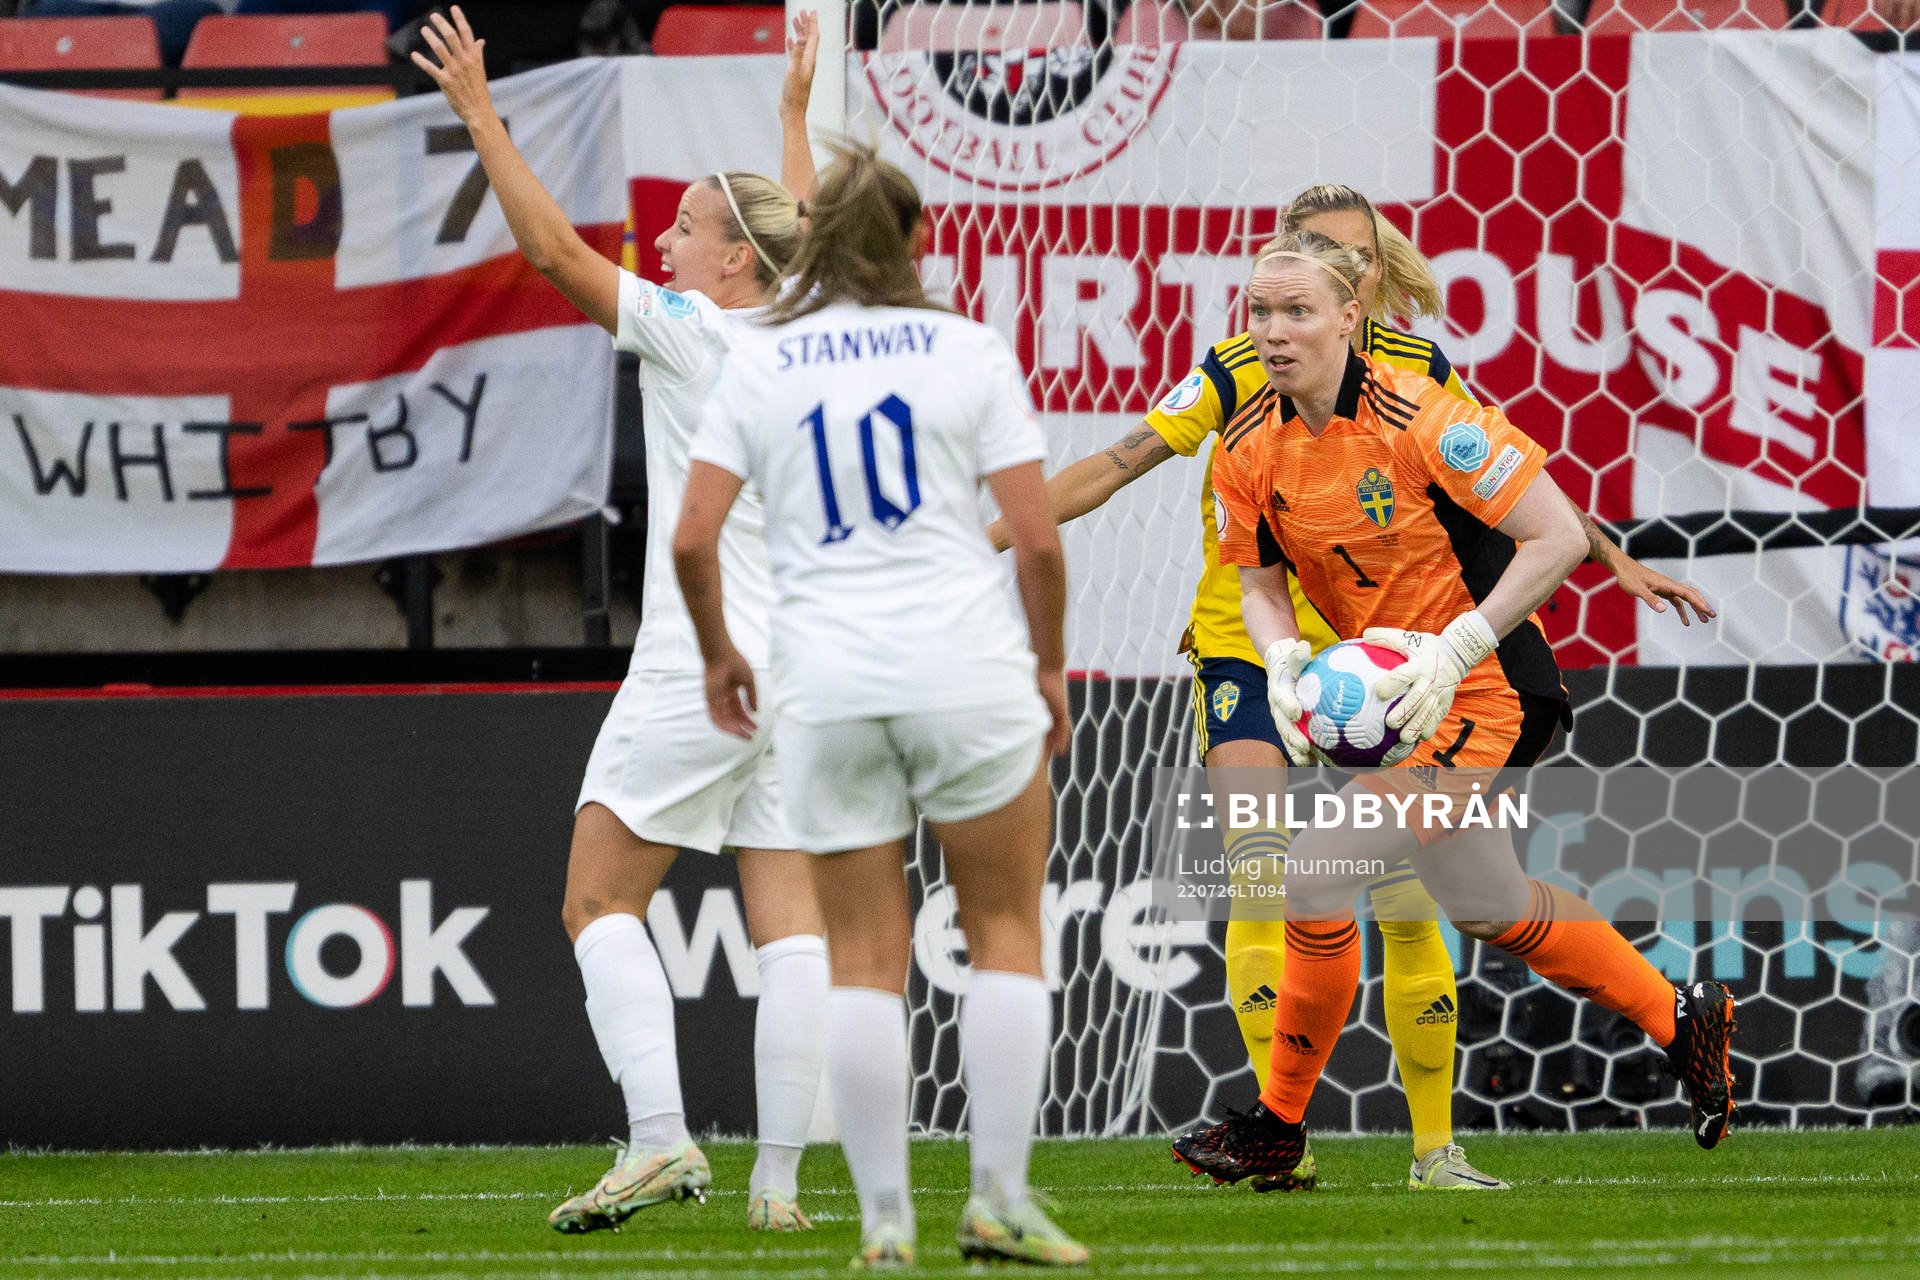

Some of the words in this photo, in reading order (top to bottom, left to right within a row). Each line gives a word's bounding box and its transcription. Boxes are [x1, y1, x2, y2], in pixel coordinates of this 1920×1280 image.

[889, 66, 1053, 171] OOTBALL
[0, 143, 343, 263] MEAD
[424, 117, 512, 245] 7
[777, 322, 940, 372] STANWAY
[13, 373, 488, 502] WHITBY
[797, 391, 922, 547] 10
[1477, 449, 1517, 497] FOUNDATION
[1332, 545, 1379, 588] 1
[1431, 716, 1476, 772] 1
[0, 878, 498, 1014] TikTok
